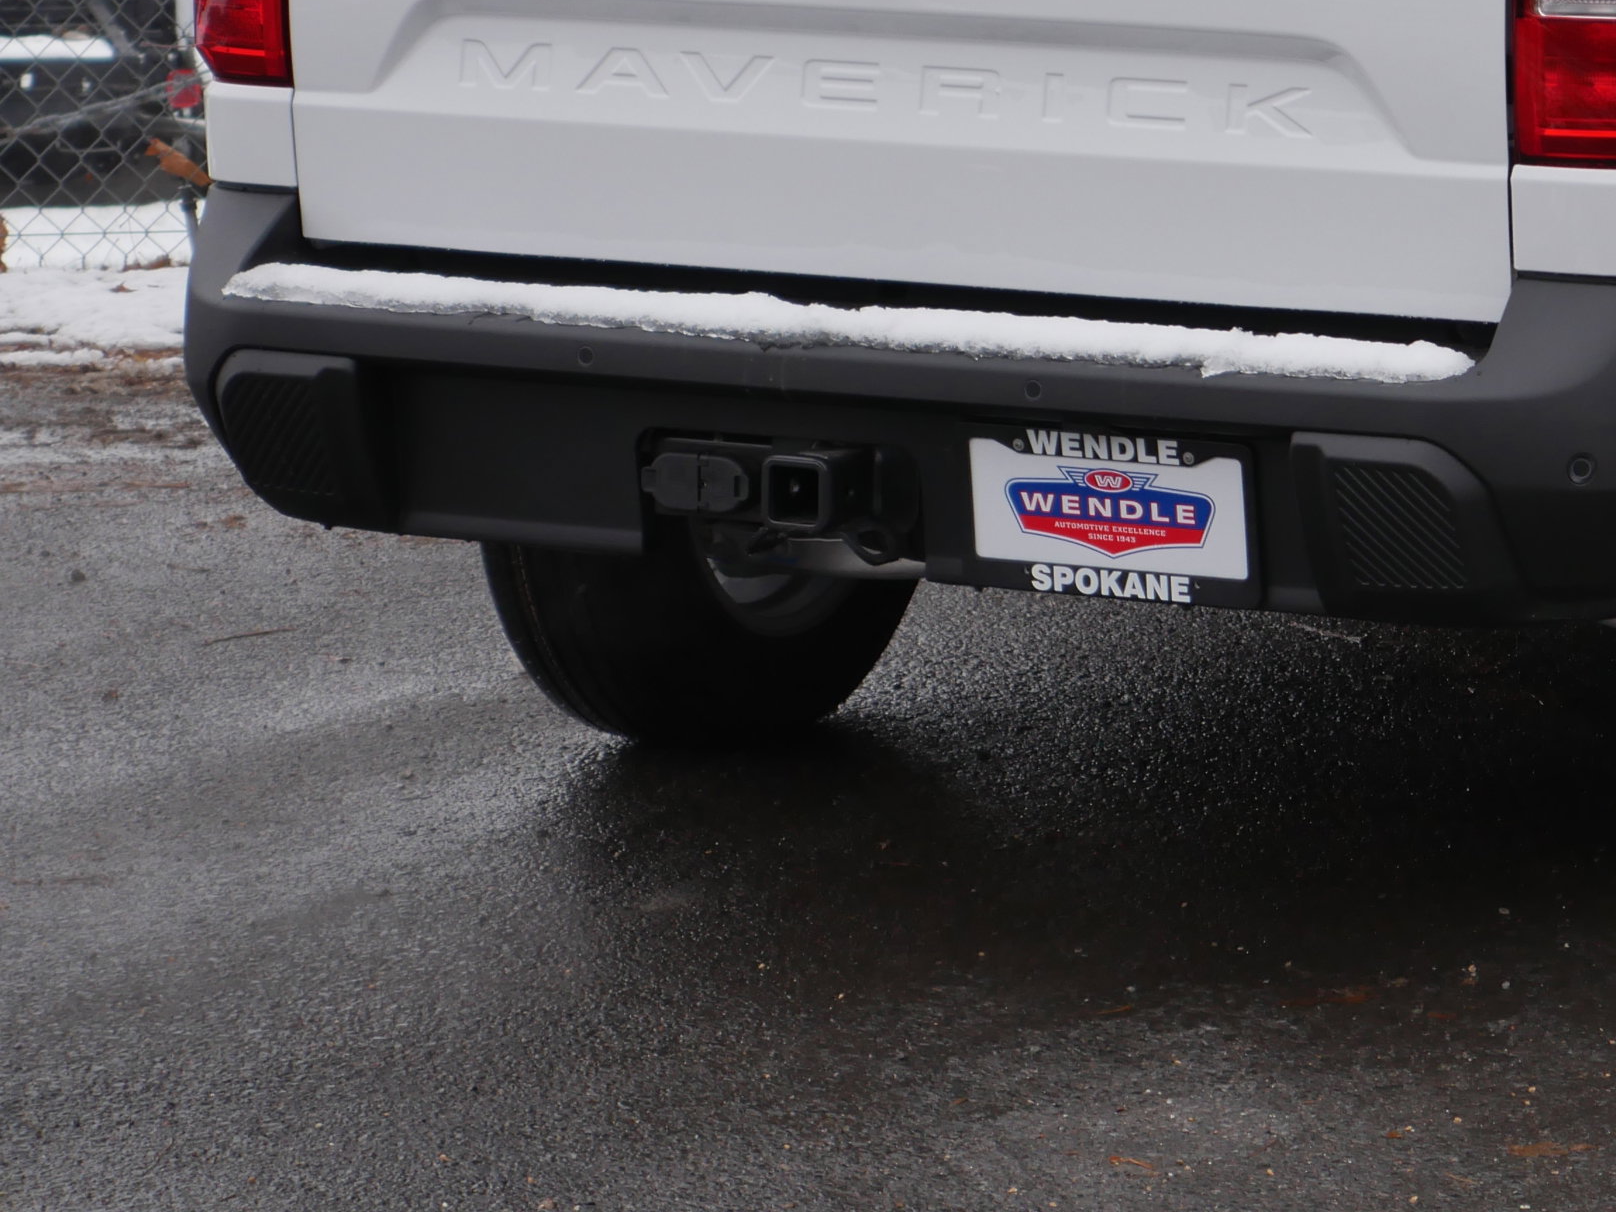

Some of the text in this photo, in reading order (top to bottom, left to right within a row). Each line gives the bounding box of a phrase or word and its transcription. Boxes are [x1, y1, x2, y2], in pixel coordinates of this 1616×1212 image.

[459, 38, 1313, 139] MAVERICK
[1026, 429, 1180, 466] WENDLE
[1020, 491, 1196, 525] WENDLE
[1054, 521, 1166, 537] AUTOMOTIVE EXCELLENCE
[1088, 533, 1136, 543] SINCE 1943
[1030, 563, 1191, 603] SPOKANE
